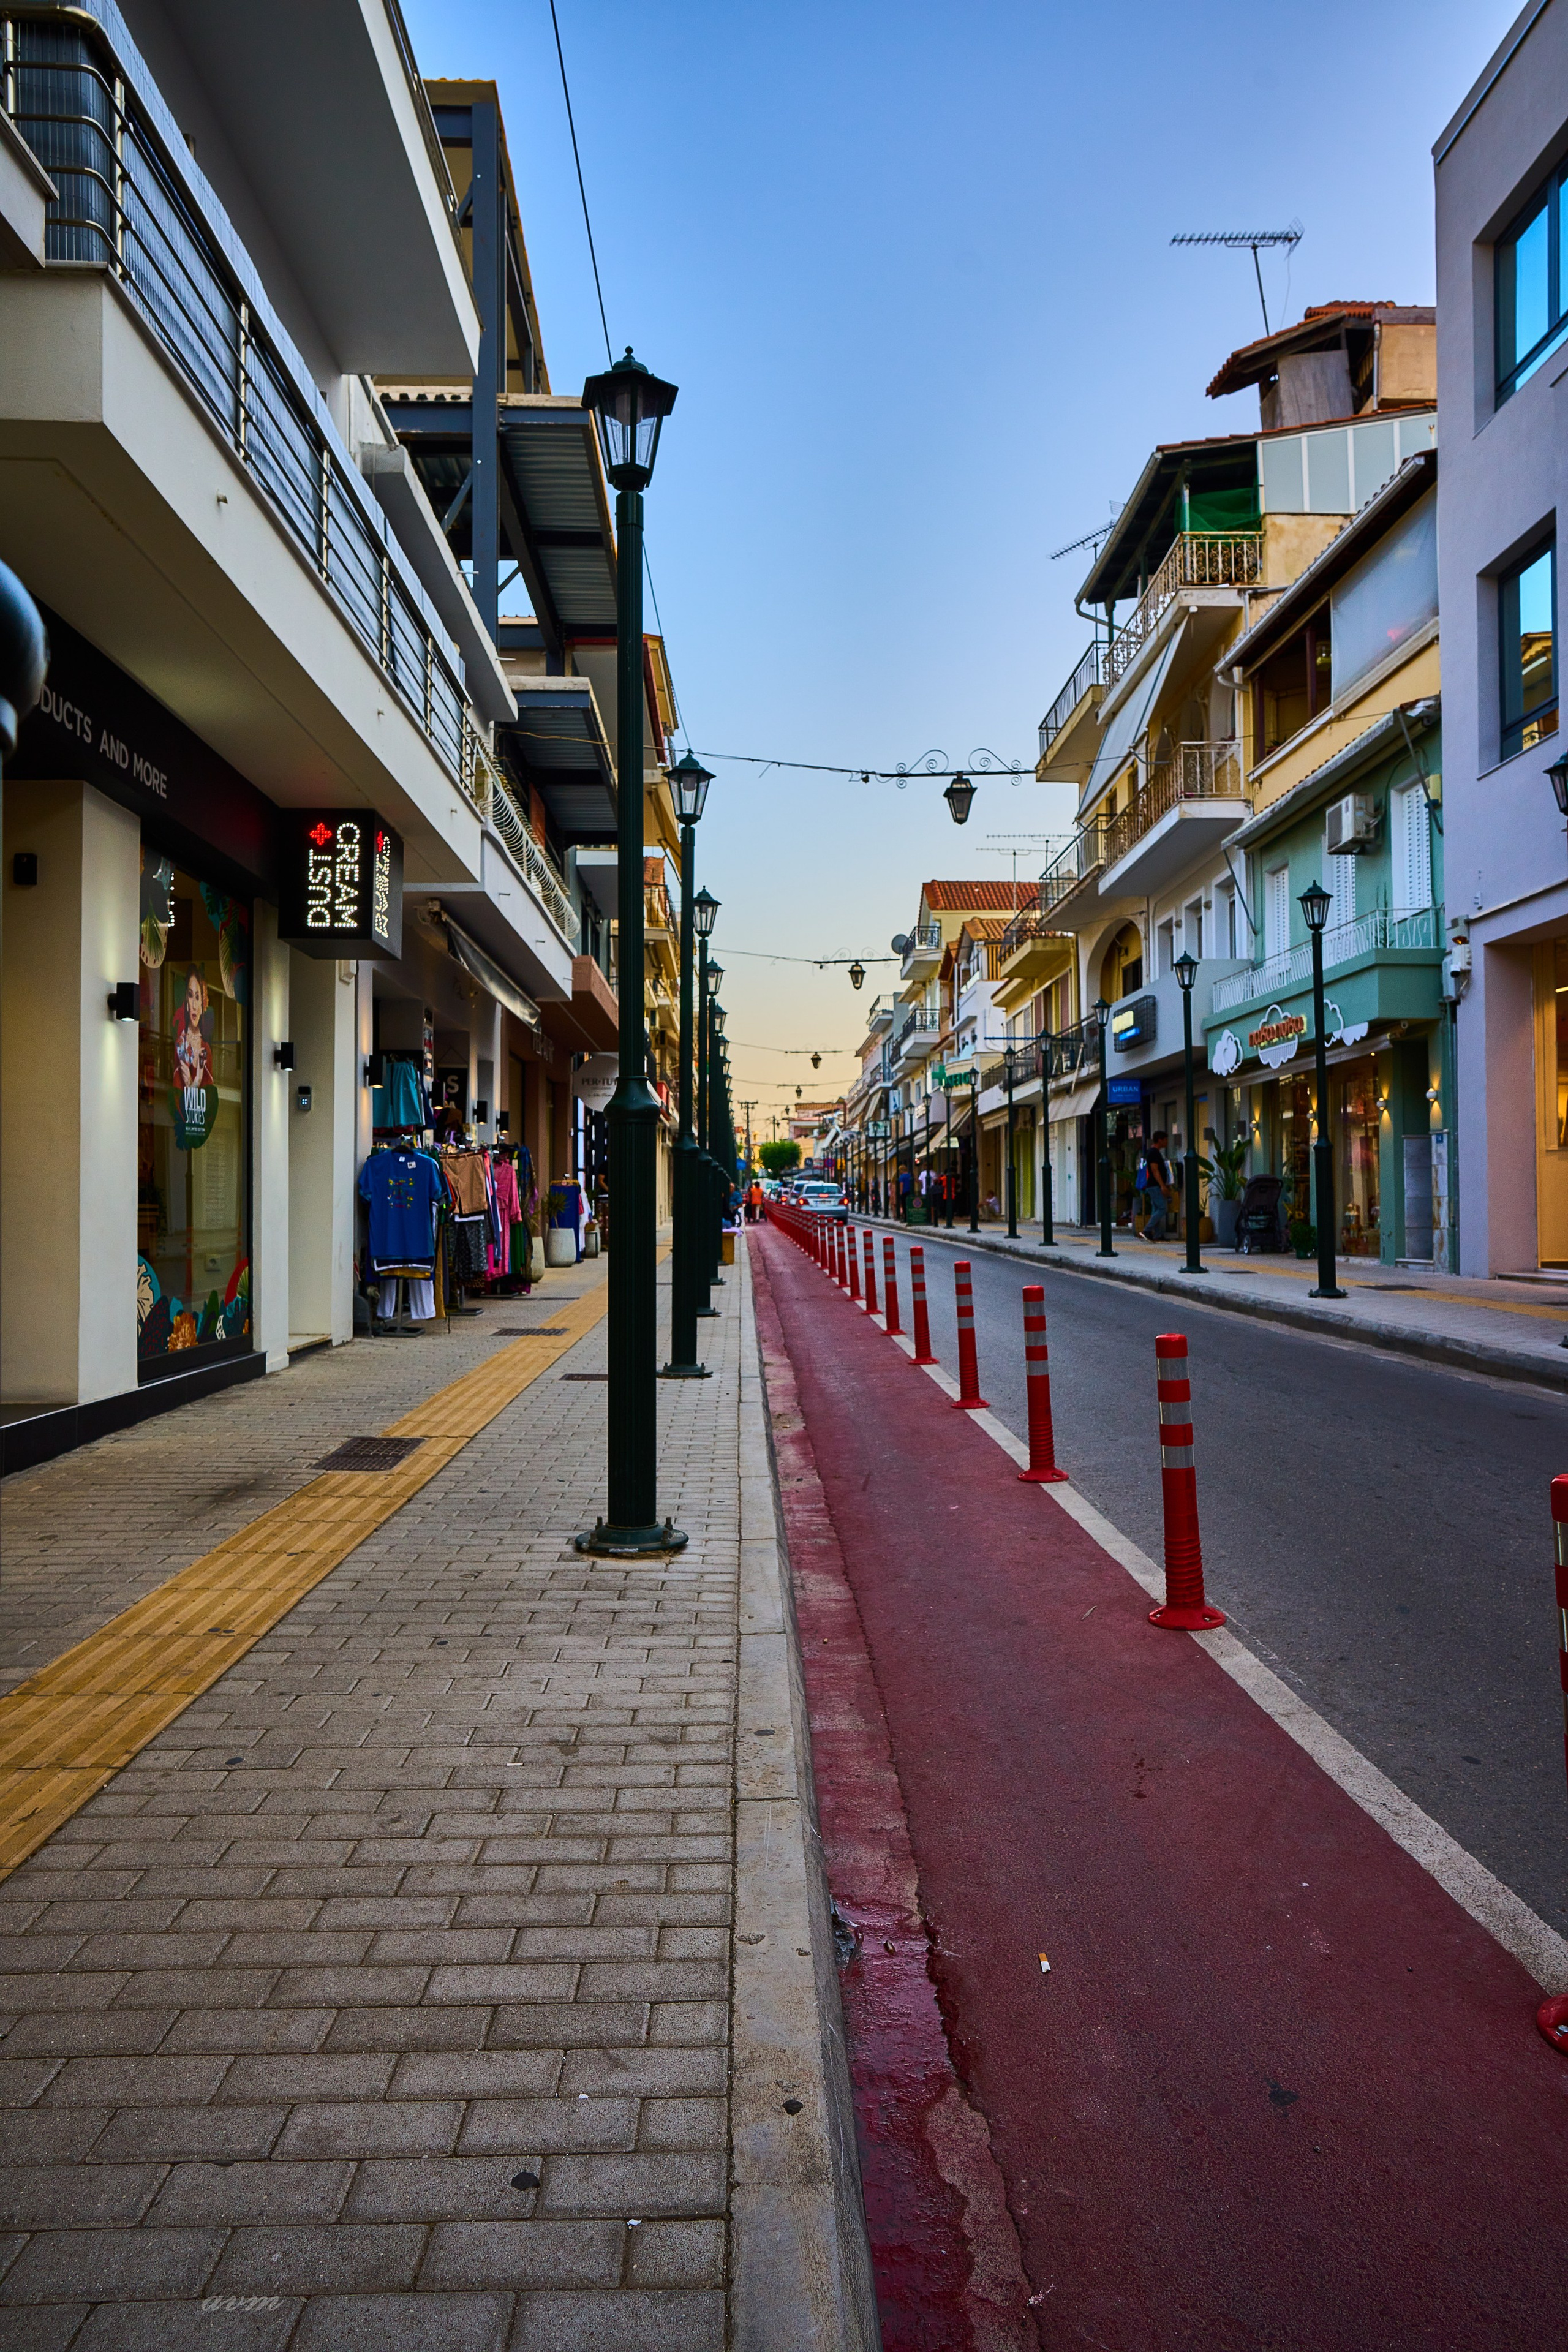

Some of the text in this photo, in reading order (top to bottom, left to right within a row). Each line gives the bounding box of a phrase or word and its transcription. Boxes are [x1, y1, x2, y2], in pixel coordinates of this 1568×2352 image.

[33, 683, 167, 799] DUCTS AND MORE
[334, 823, 360, 927] CREAM
[184, 1086, 206, 1112] WILD
